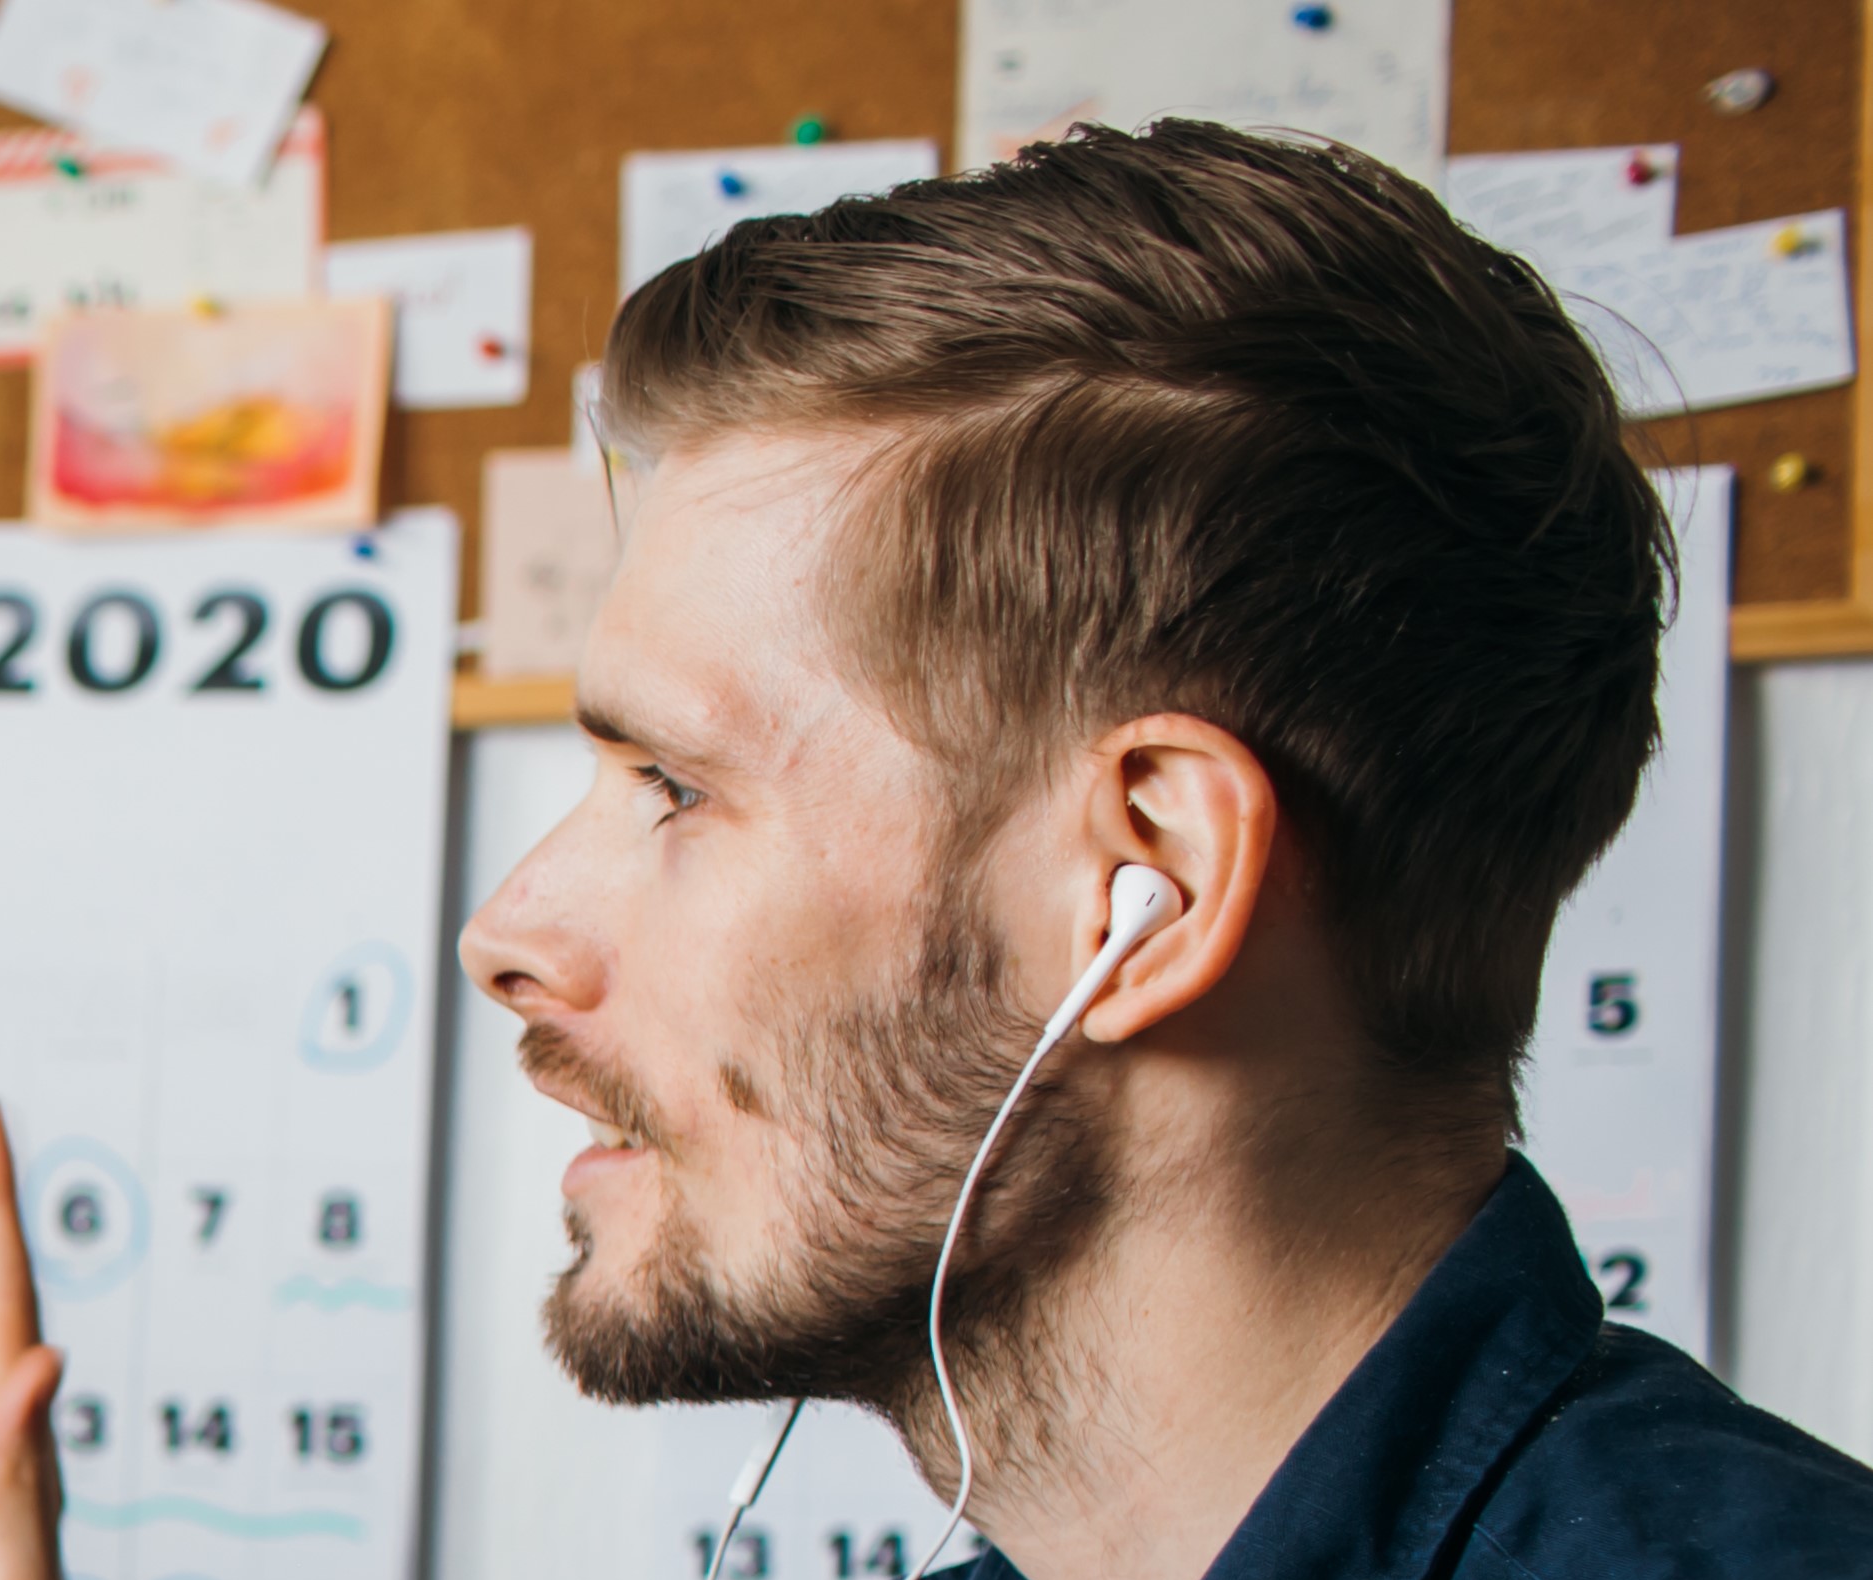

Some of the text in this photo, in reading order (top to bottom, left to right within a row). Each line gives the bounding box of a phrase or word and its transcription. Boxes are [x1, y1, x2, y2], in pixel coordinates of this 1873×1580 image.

[331, 978, 363, 1030] 1
[1584, 970, 1643, 1040] 5
[58, 1184, 104, 1239] 6
[189, 1187, 230, 1243] 7
[317, 1193, 362, 1248] 8
[1597, 1246, 1650, 1312] 2
[65, 1394, 109, 1452] 3
[155, 1398, 237, 1456] 14
[287, 1403, 367, 1463] 15
